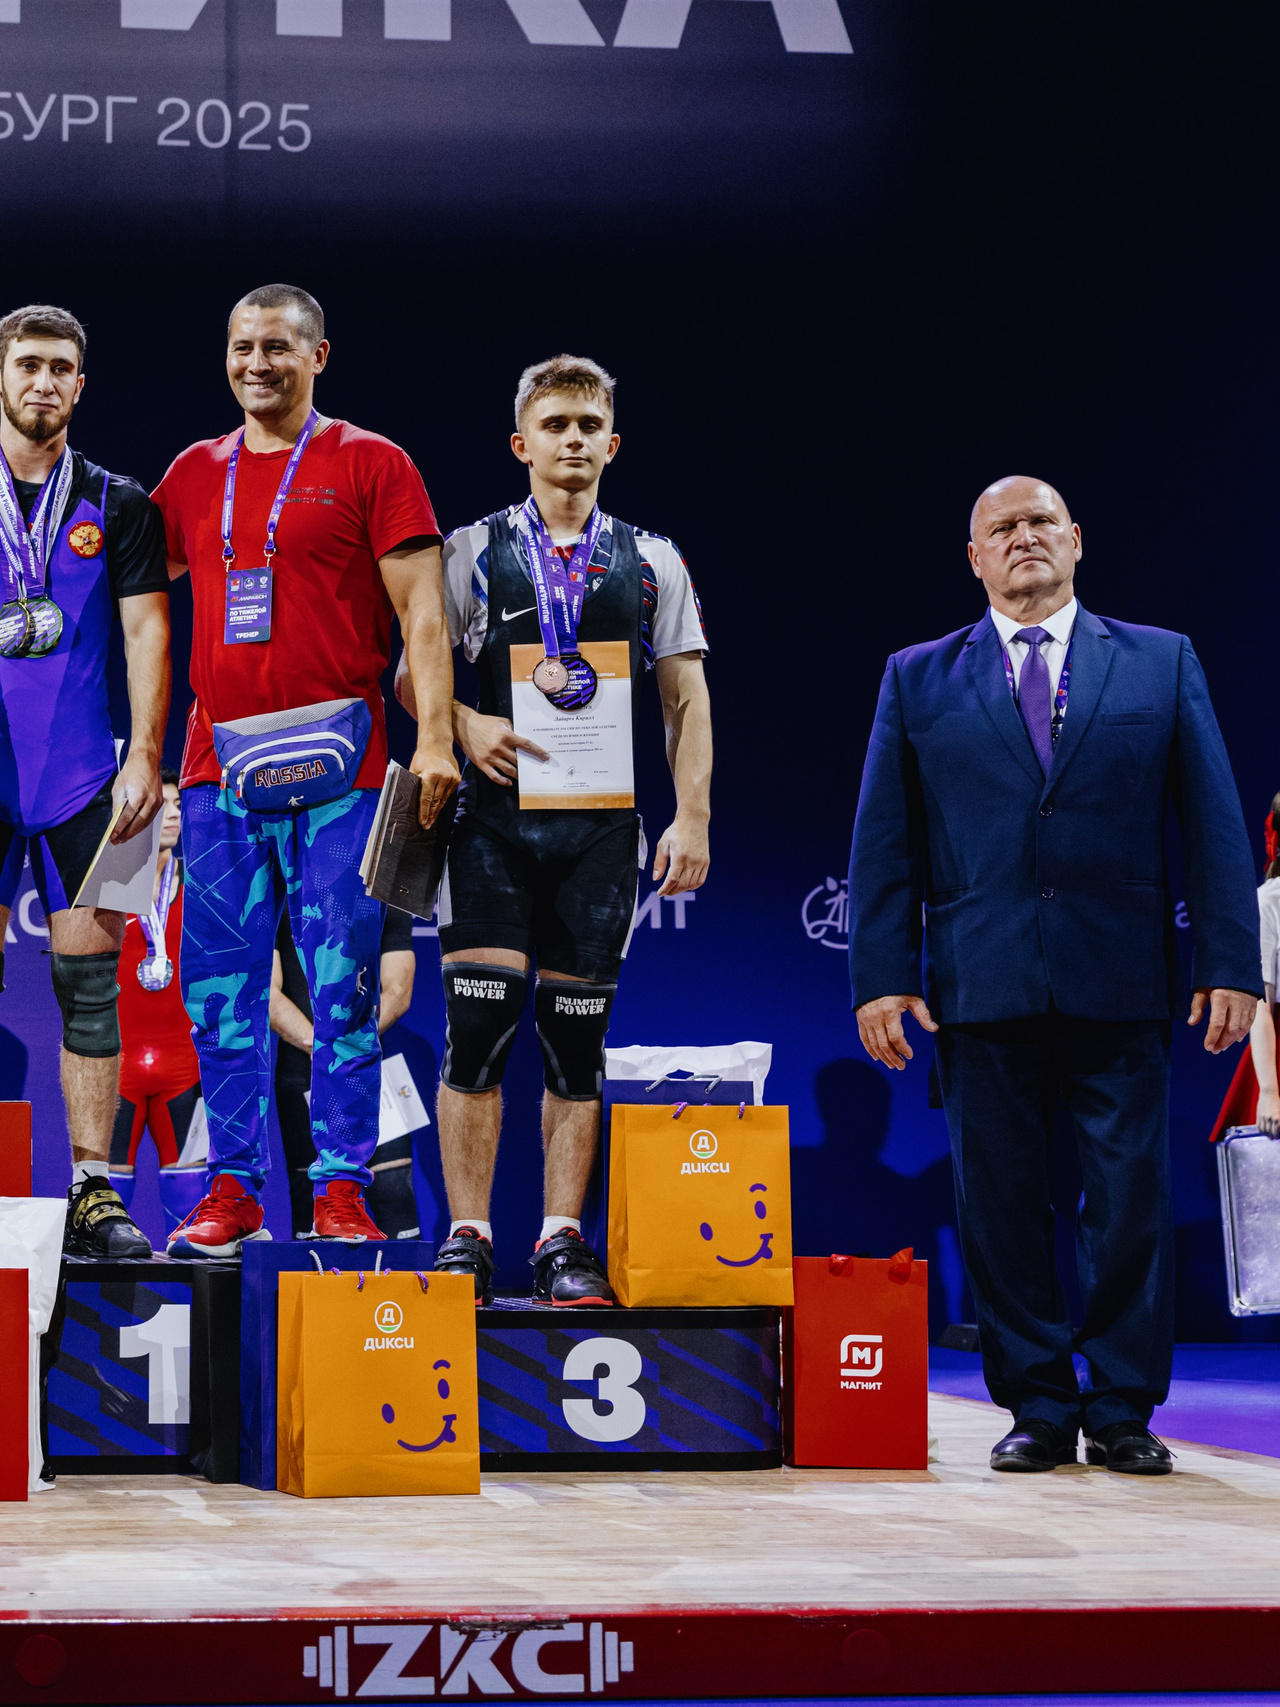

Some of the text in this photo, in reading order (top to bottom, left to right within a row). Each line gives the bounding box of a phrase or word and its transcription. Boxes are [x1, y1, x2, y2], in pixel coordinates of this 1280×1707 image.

[155, 96, 313, 152] 2025
[239, 606, 267, 615] ТЯЖЕЛОЙ
[254, 759, 328, 788] RUSSIA
[454, 978, 506, 989] UNLIMITED
[454, 986, 505, 1000] POWER
[556, 996, 606, 1006] UNLIMITED
[555, 1004, 604, 1016] POWER
[119, 1304, 190, 1424] 1
[562, 1337, 646, 1442] 3
[840, 1381, 882, 1390] МАГНИТ
[354, 1622, 584, 1696] ZKC
